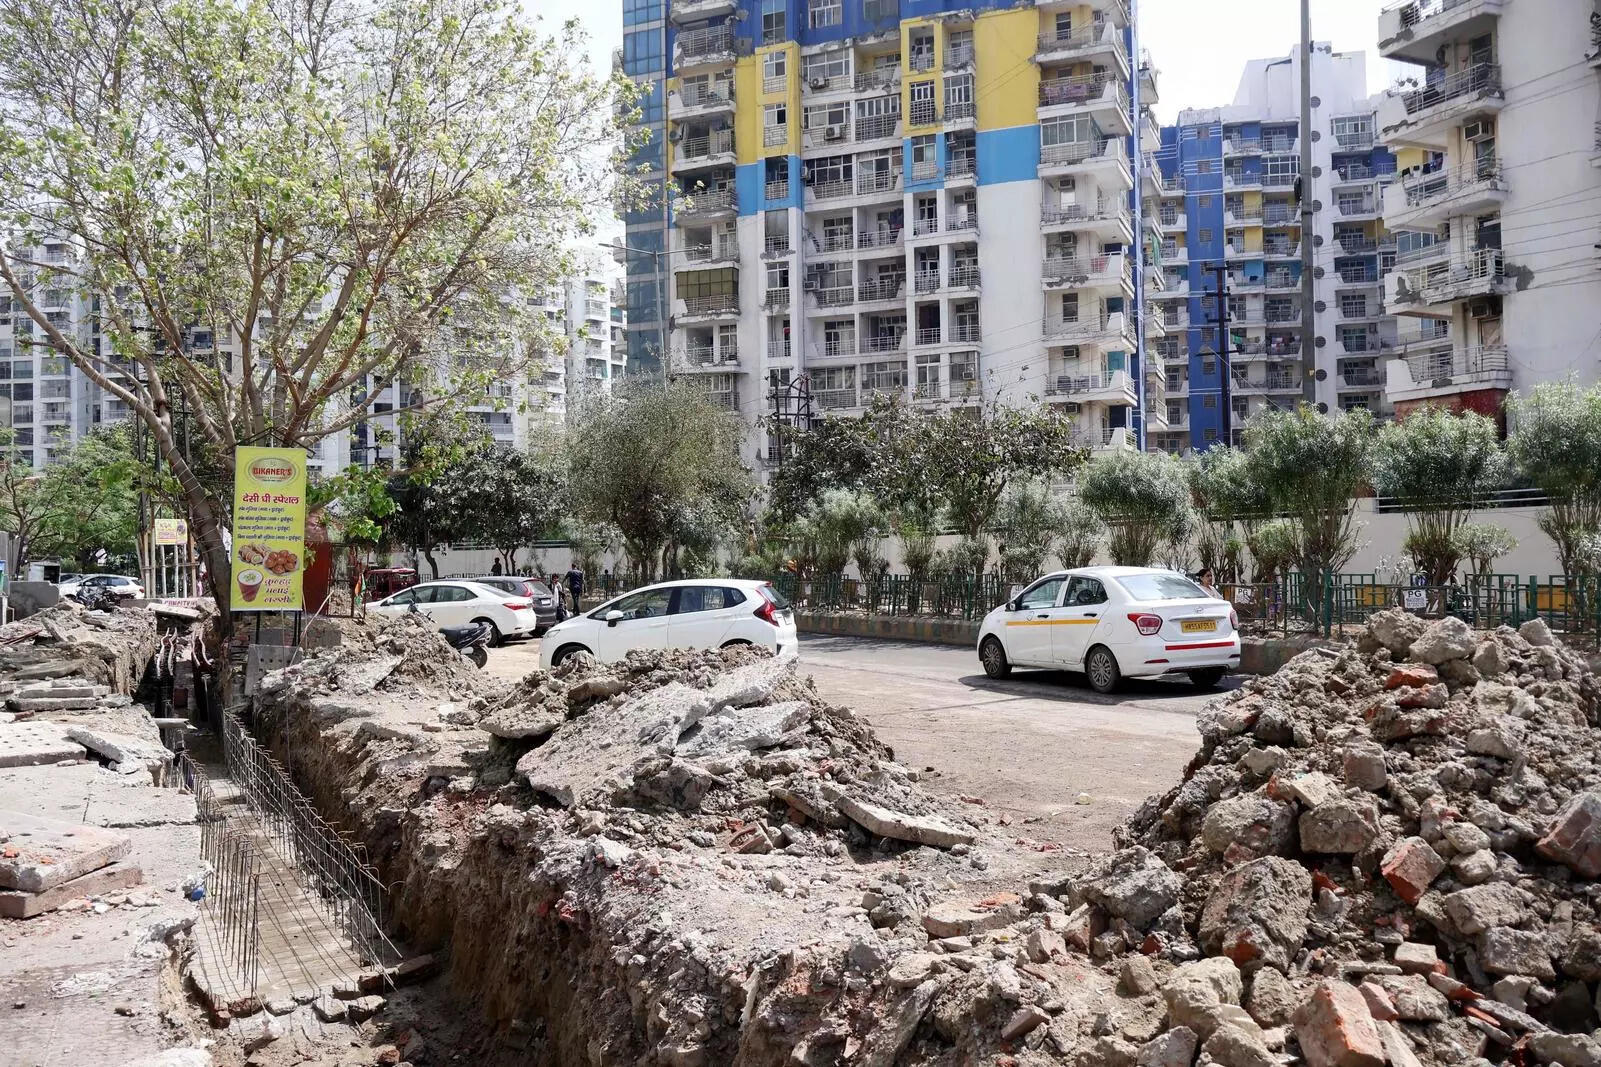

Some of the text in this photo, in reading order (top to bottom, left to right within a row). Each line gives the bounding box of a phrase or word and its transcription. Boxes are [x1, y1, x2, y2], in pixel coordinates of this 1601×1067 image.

[253, 467, 292, 476] BIKANER'S
[242, 493, 300, 504] देसी घी स्पेशल
